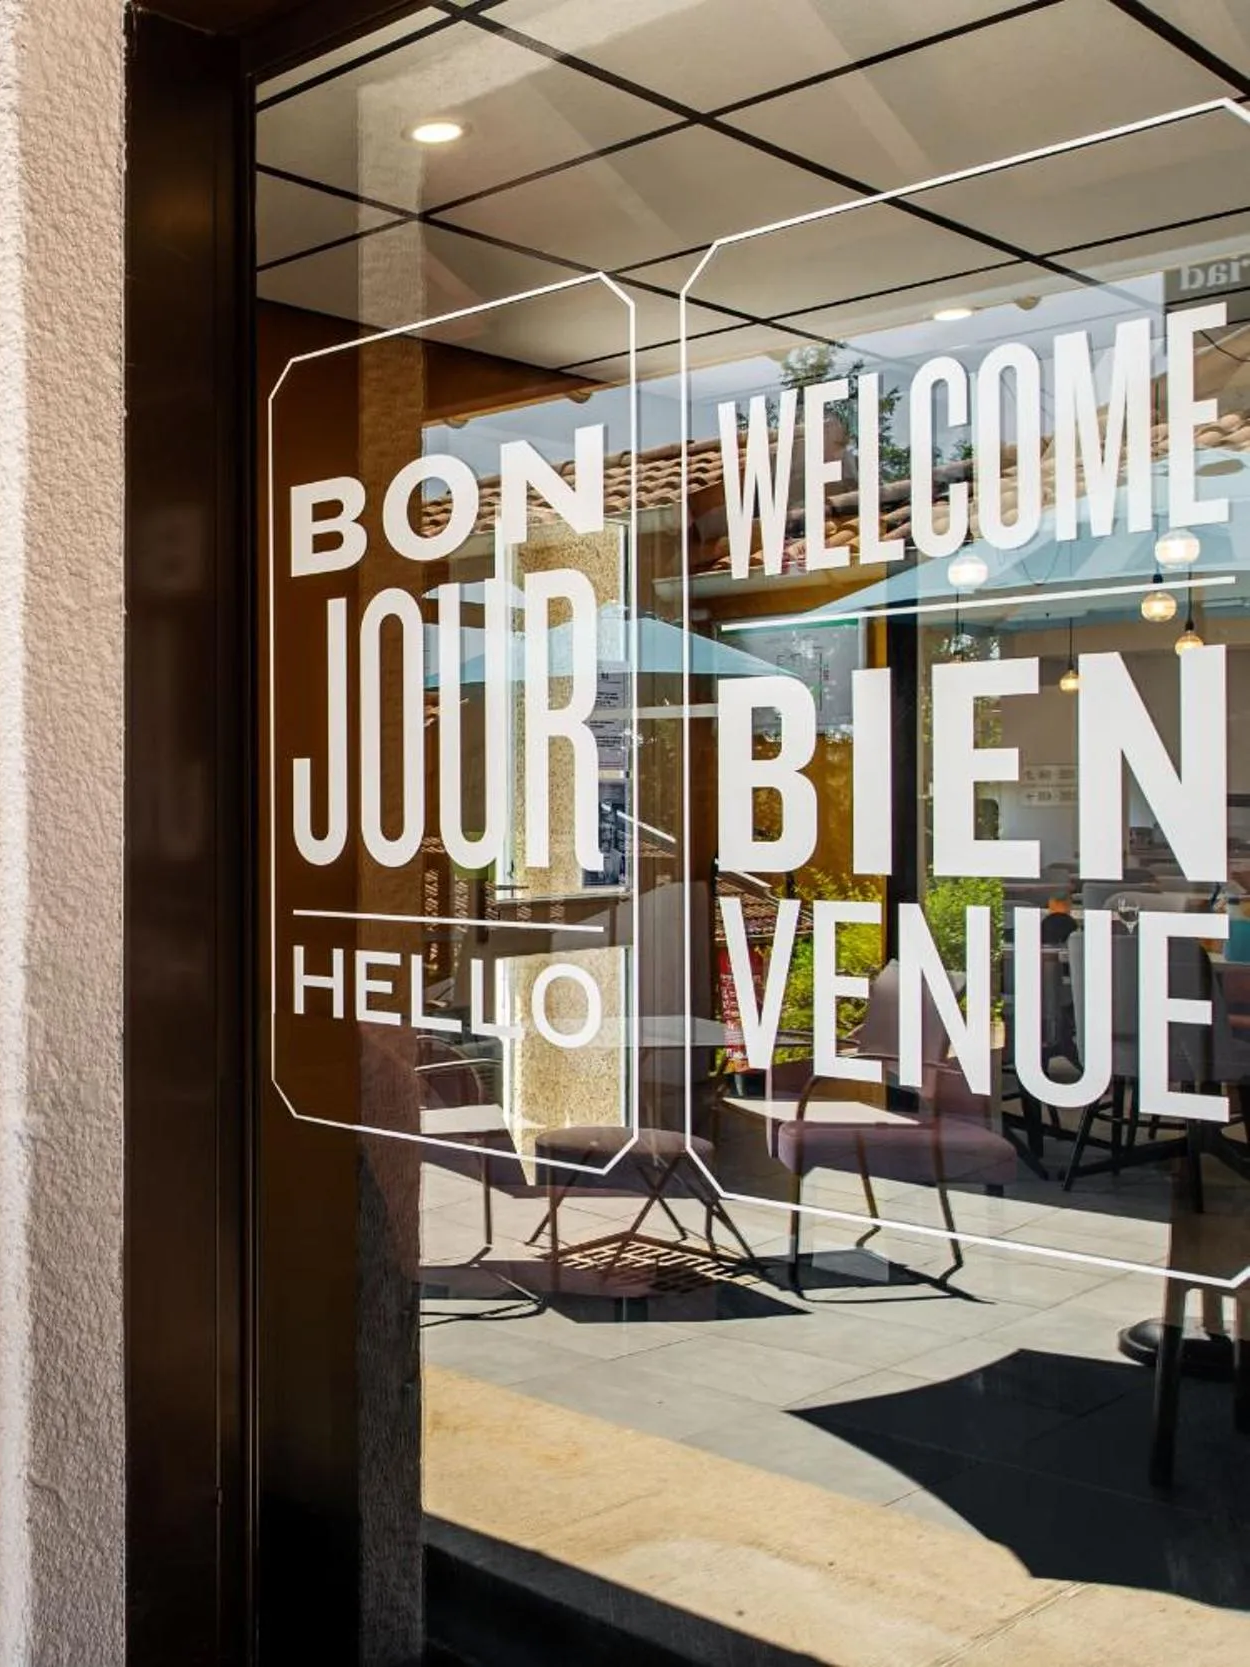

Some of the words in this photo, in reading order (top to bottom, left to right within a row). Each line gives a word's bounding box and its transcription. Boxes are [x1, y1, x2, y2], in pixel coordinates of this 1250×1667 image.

[290, 423, 605, 578] BON
[718, 302, 1230, 580] WELCOME
[293, 567, 604, 871] JOUR
[717, 644, 1227, 882] BIEN
[293, 944, 601, 1048] HELLO
[718, 897, 1230, 1123] VENUE
